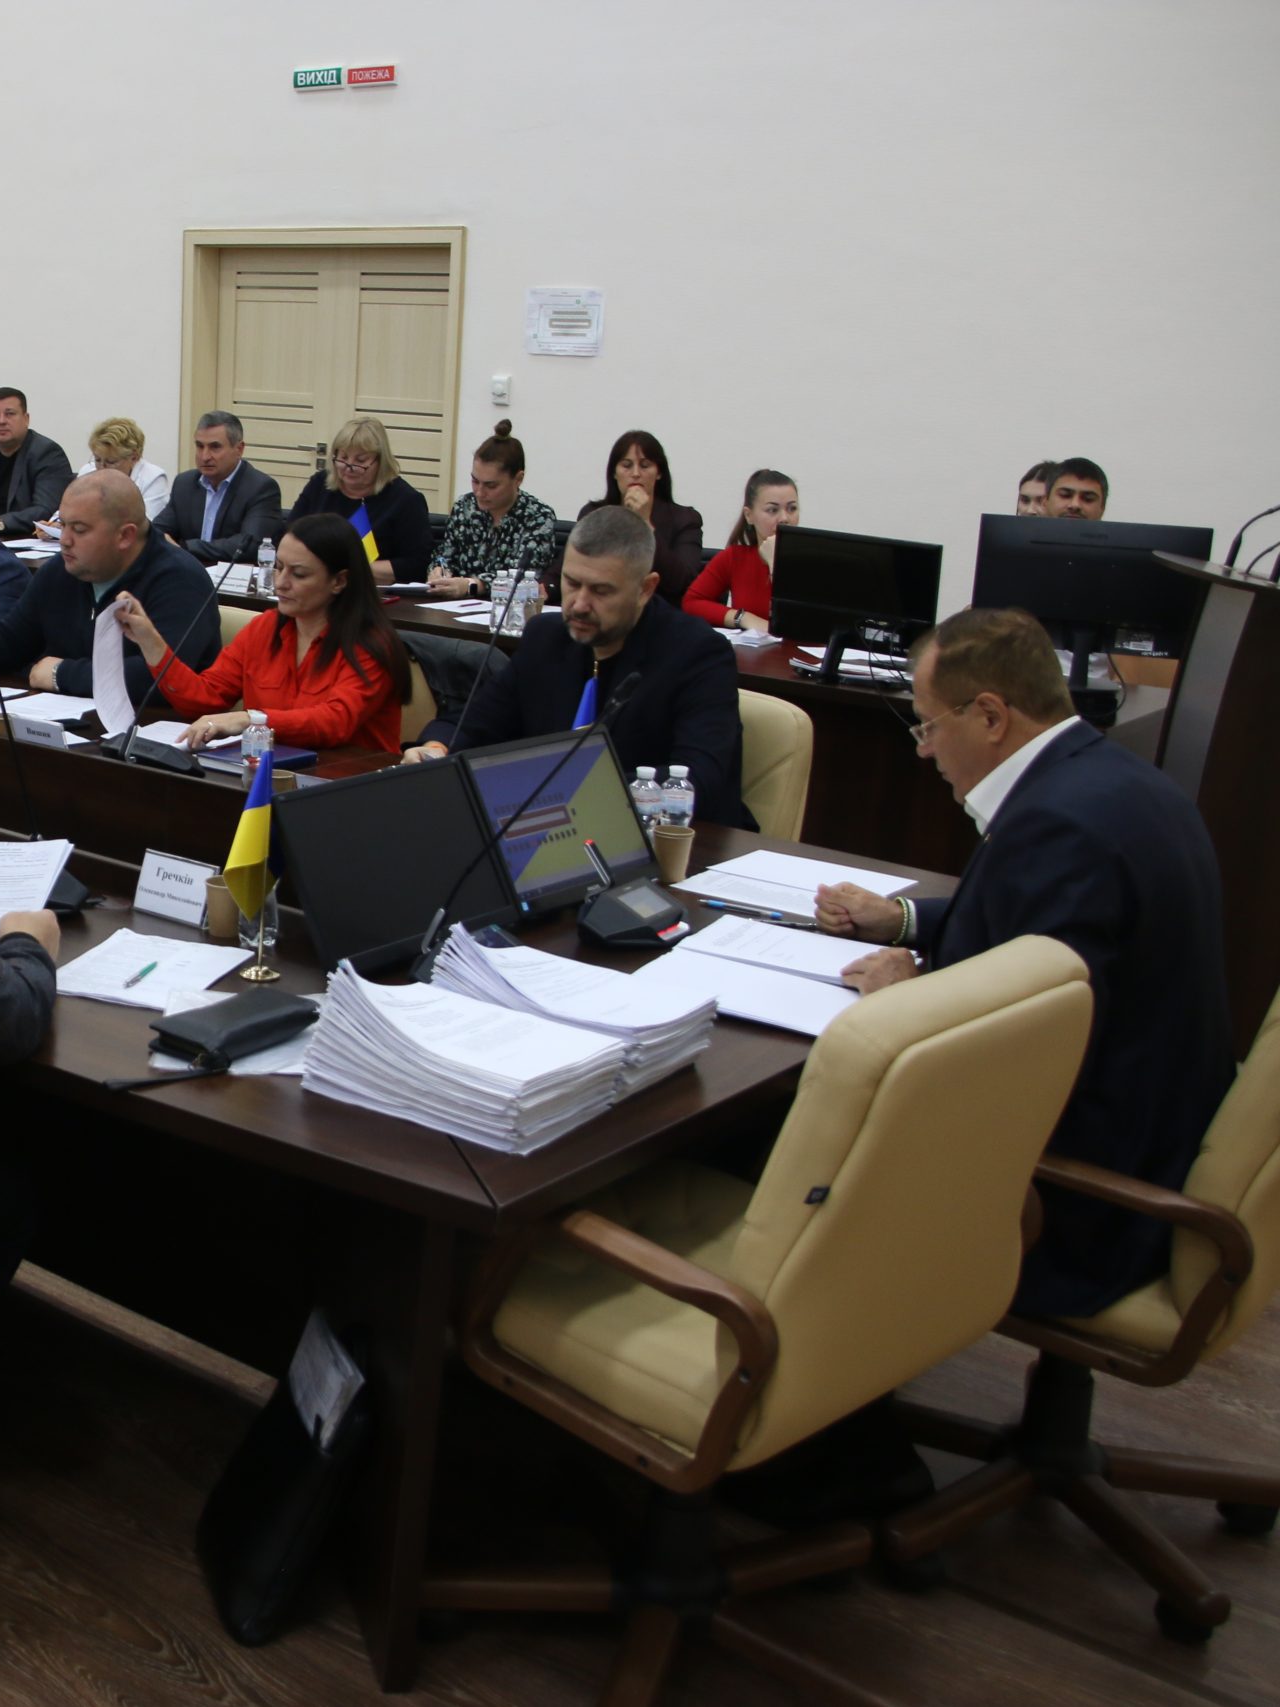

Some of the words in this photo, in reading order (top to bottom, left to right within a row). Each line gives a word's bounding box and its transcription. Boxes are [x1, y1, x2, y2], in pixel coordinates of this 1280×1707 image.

[297, 70, 337, 85] ВИХІД
[351, 69, 390, 81] ПОЖЕЖА
[156, 867, 194, 885] Гречкін
